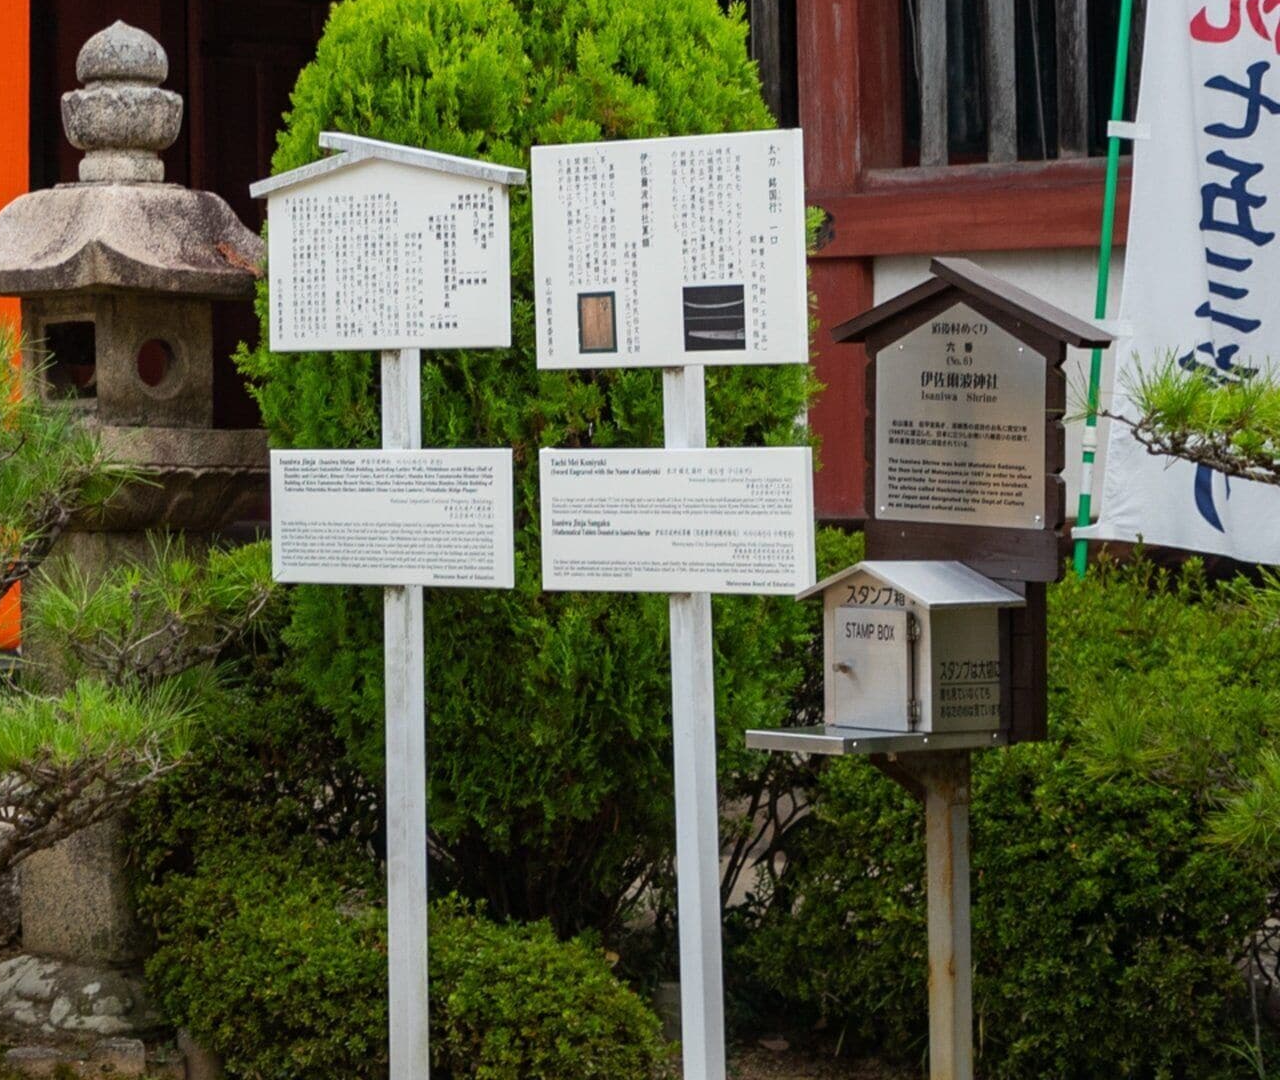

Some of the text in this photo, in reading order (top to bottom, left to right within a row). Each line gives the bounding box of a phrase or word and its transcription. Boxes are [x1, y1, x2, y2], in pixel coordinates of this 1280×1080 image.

[921, 391, 998, 403] Isaniwa Shrine
[845, 622, 895, 641] STAMP BOX
